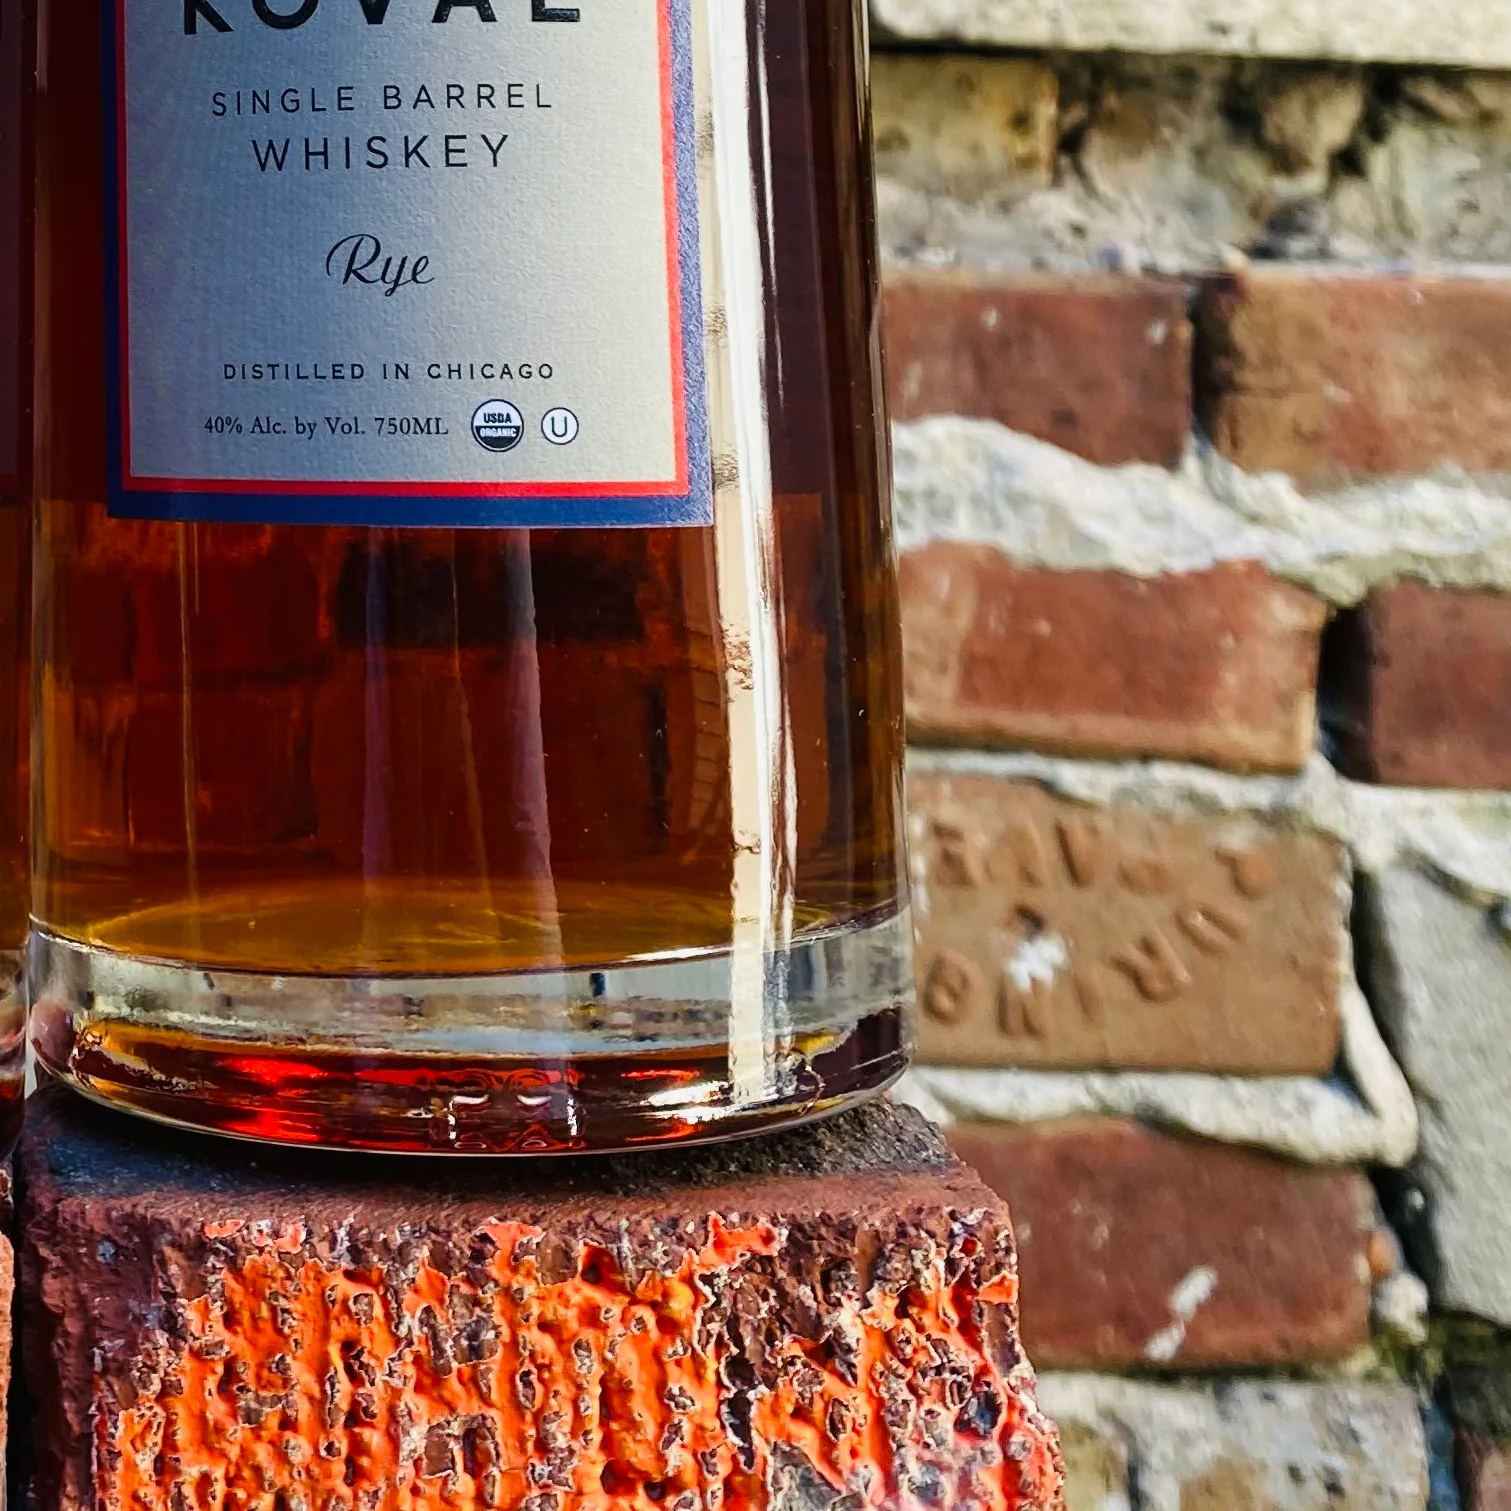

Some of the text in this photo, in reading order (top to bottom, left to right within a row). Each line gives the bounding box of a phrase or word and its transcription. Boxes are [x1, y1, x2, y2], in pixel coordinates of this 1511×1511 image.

[212, 83, 553, 117] SINGLE BARREL
[250, 134, 509, 172] WHISKEY
[325, 233, 435, 296] Rye
[223, 362, 554, 381] DISTILLED IN CHICAGO
[204, 415, 450, 442] 40% Alc. by Vol. 750ML
[483, 412, 512, 424] USDA
